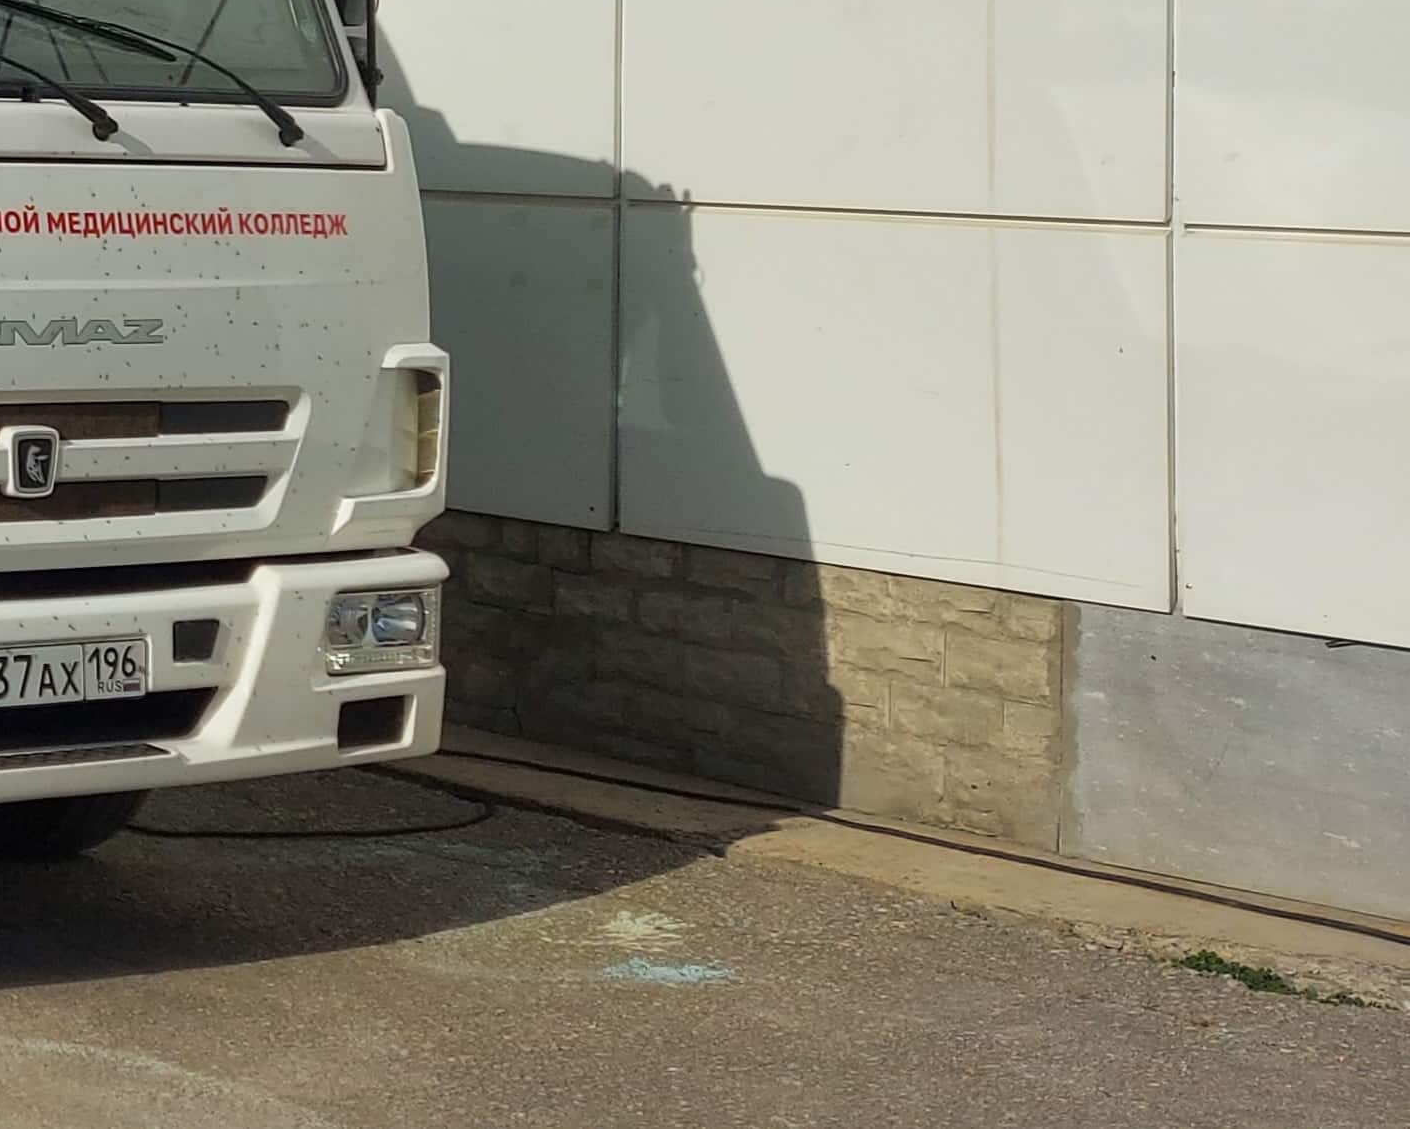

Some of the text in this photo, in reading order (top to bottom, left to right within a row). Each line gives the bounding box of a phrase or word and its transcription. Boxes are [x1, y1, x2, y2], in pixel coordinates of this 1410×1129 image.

[46, 207, 234, 238] МЕДИЦИНСКИЙ
[239, 212, 348, 239] КОЛЛЕДЖ
[87, 645, 137, 680] 196
[97, 679, 123, 692] RUS
